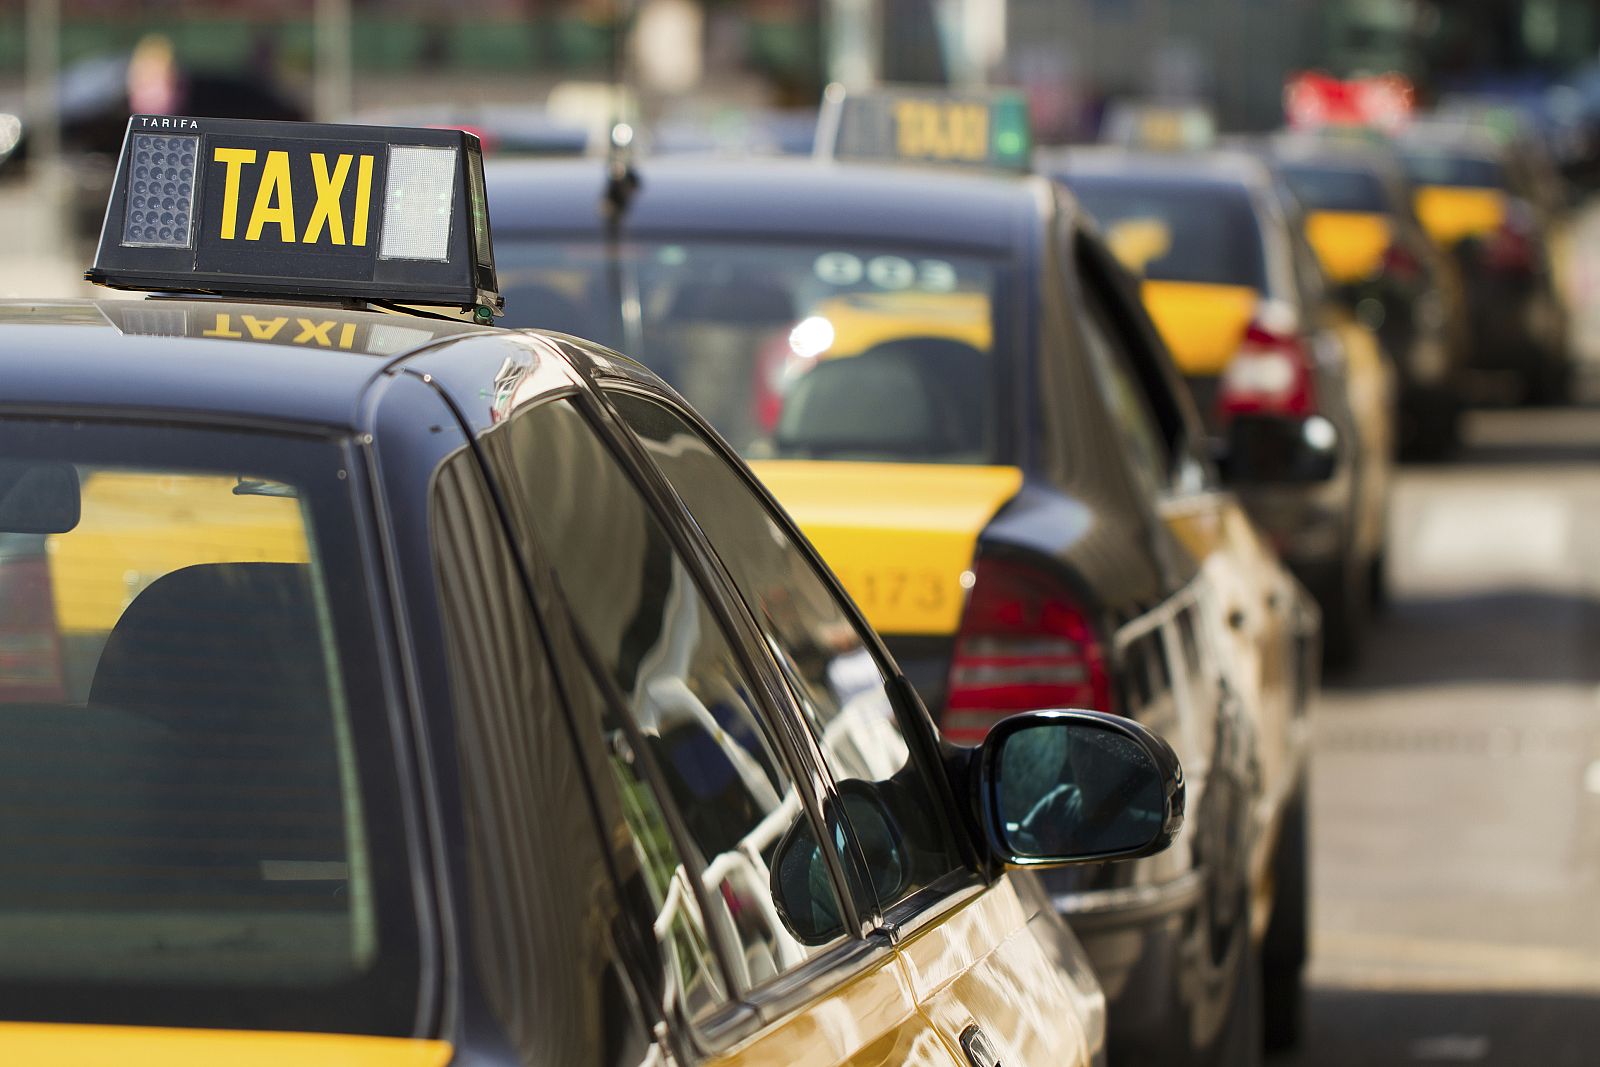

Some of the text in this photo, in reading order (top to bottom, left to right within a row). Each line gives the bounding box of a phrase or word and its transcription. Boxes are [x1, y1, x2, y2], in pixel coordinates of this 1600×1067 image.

[141, 118, 199, 129] TARIFA
[894, 101, 988, 160] TAXI
[214, 147, 375, 247] TAXI
